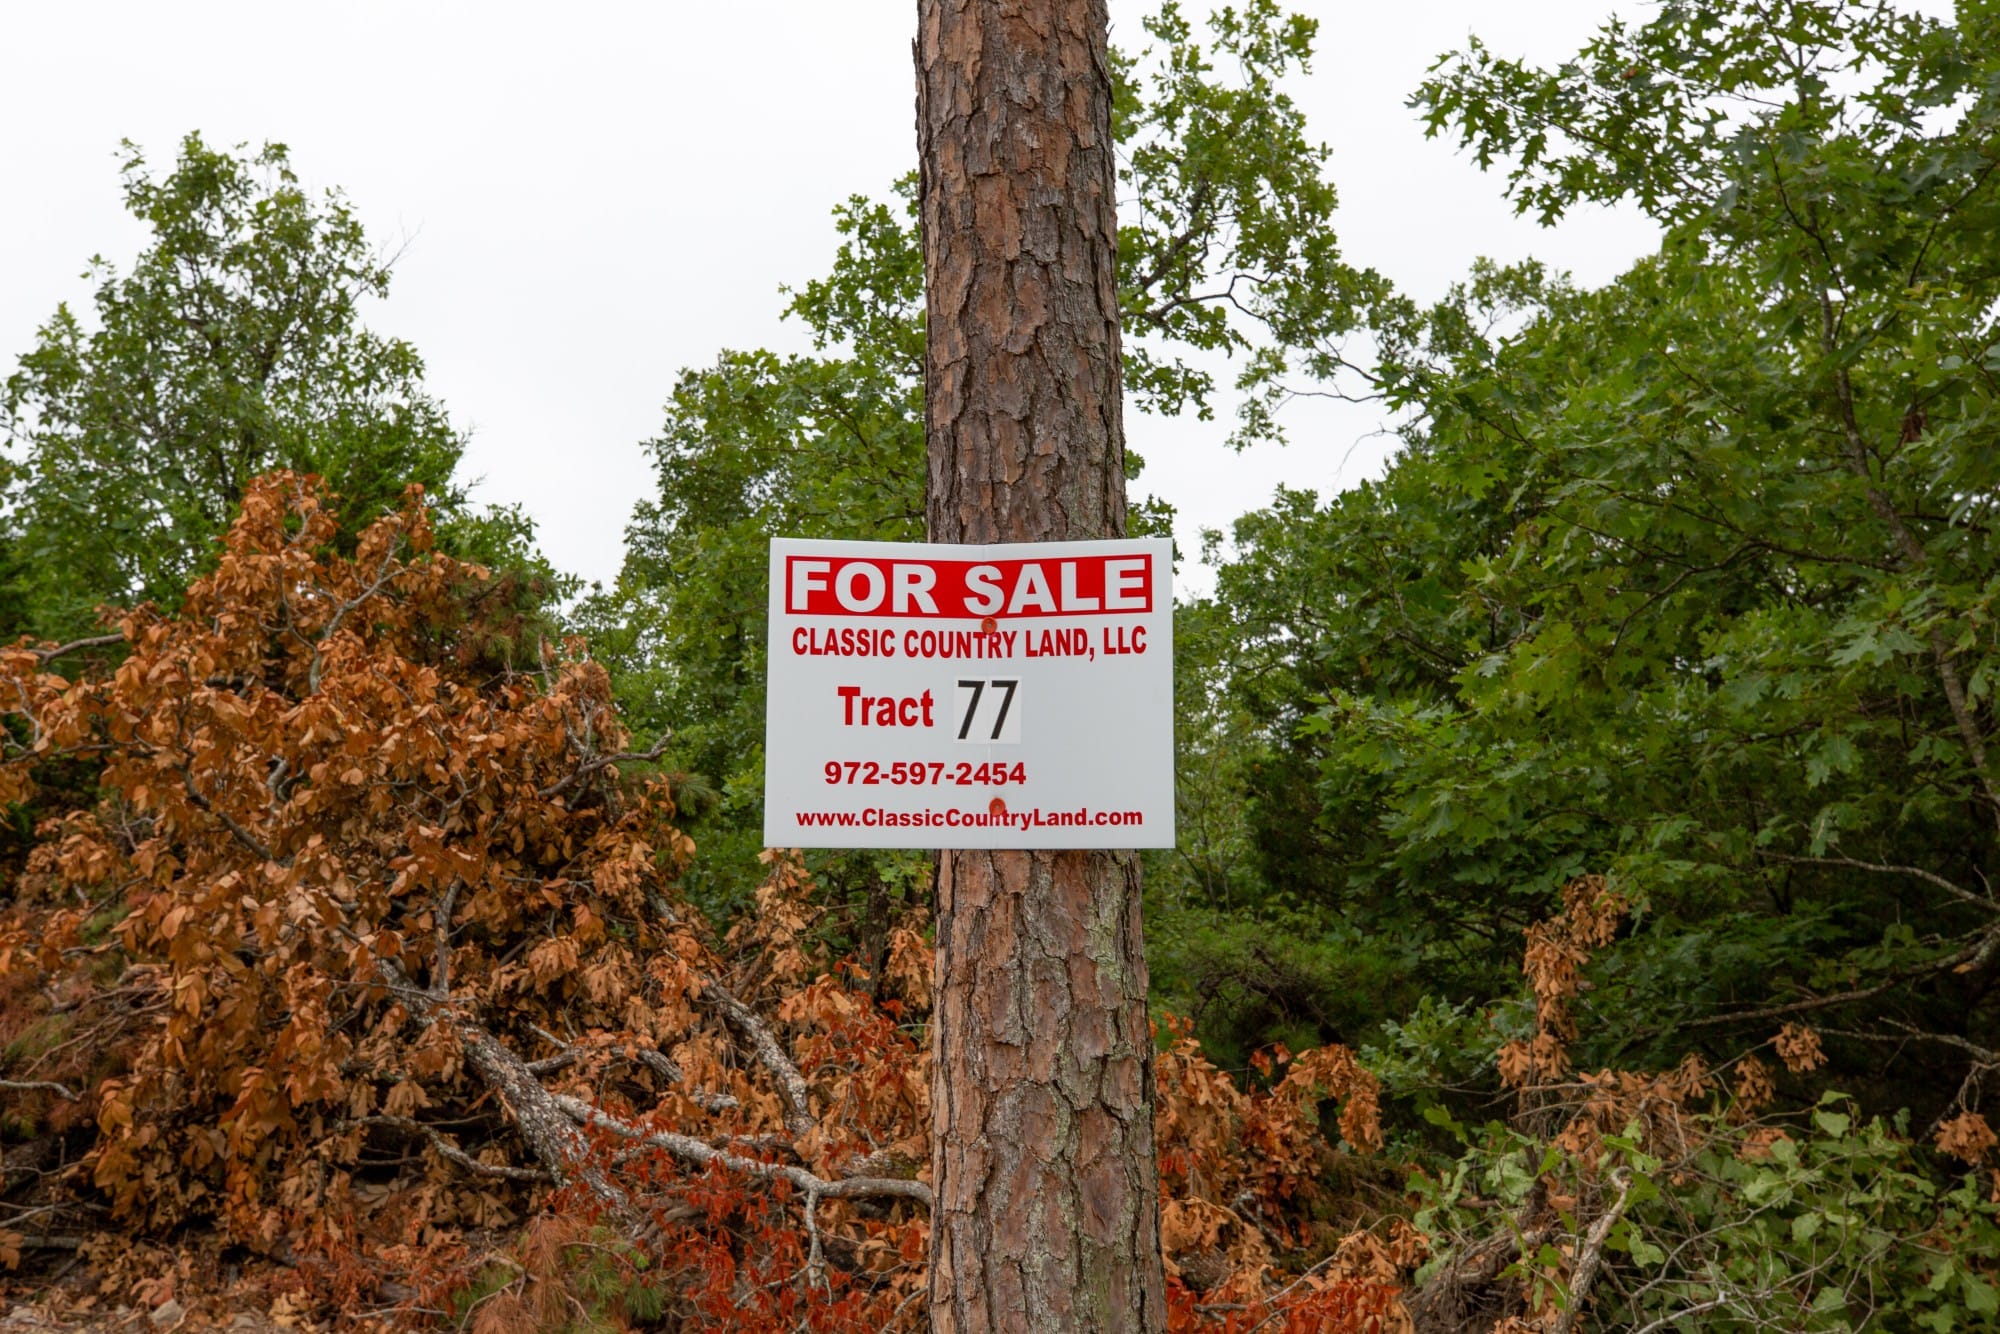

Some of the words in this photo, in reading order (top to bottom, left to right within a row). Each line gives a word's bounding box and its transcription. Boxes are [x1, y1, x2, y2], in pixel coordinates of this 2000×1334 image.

[792, 560, 940, 614] FOR
[962, 558, 1148, 616] SALE
[792, 626, 896, 657] CLASSIC
[903, 629, 1018, 659] COUNTRY
[1025, 627, 1095, 662] LAND,
[1103, 625, 1147, 655] LLC
[837, 686, 934, 728] Tract
[957, 679, 1019, 740] 77
[824, 761, 1027, 786] 972-597-2454
[796, 807, 1143, 831] www.ClassicCountryLand.com
